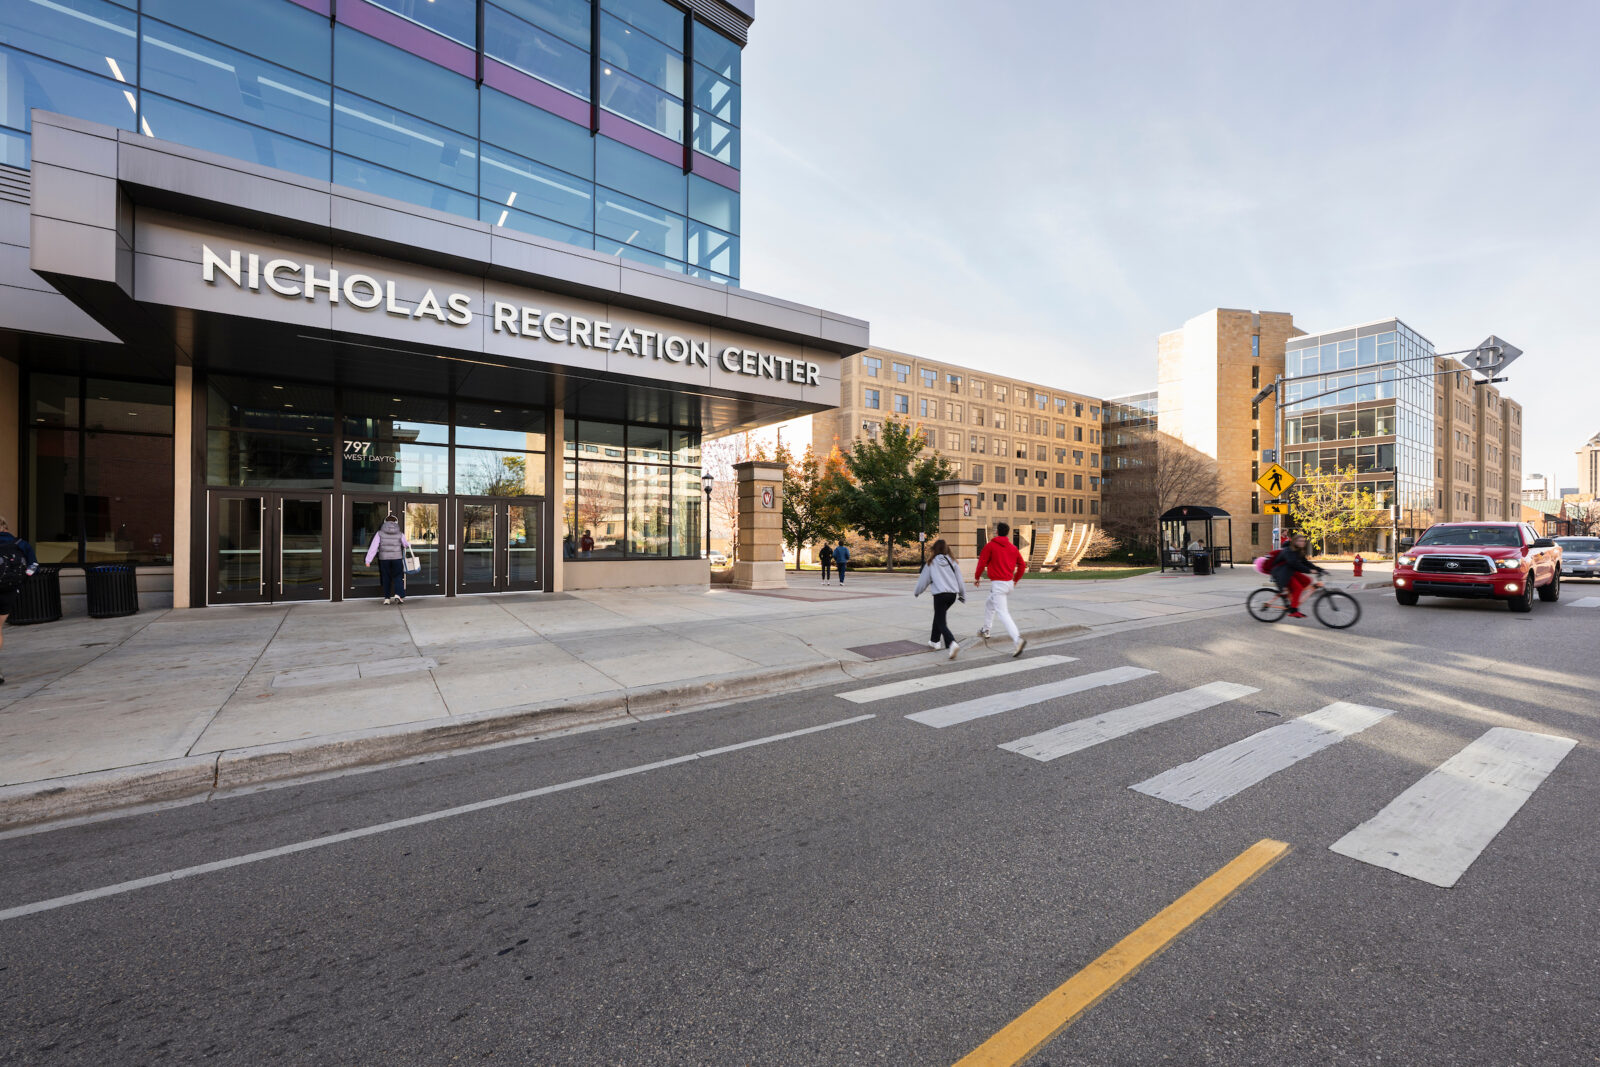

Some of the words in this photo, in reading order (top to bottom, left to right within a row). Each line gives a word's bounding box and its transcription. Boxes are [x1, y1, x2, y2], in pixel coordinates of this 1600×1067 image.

[203, 244, 473, 325] NICHOLAS
[493, 301, 709, 367] RECREATION
[721, 347, 820, 386] CENTER
[343, 440, 371, 453] 797
[343, 453, 366, 461] WEST
